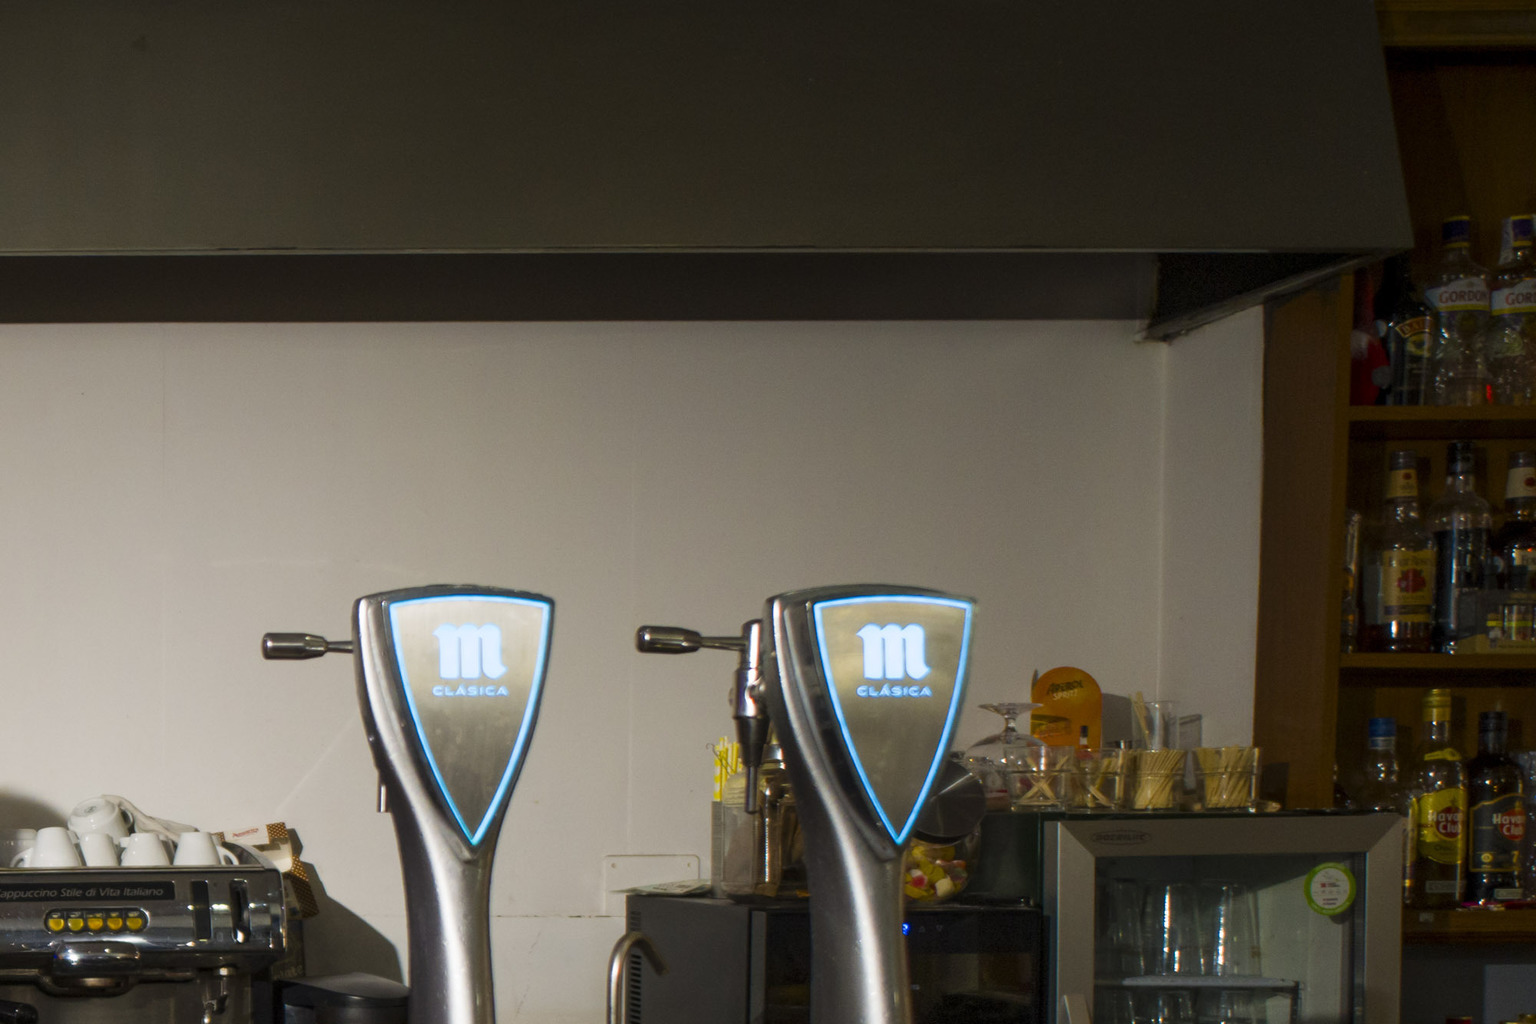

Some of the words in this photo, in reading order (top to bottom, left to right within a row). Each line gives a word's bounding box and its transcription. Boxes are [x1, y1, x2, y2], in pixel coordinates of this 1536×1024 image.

[431, 684, 510, 698] CLÁSICA
[856, 683, 934, 698] CLÁSICA
[60, 887, 83, 898] Stile
[85, 887, 96, 897] di
[99, 887, 120, 897] Vita
[123, 886, 164, 897] Italiano
